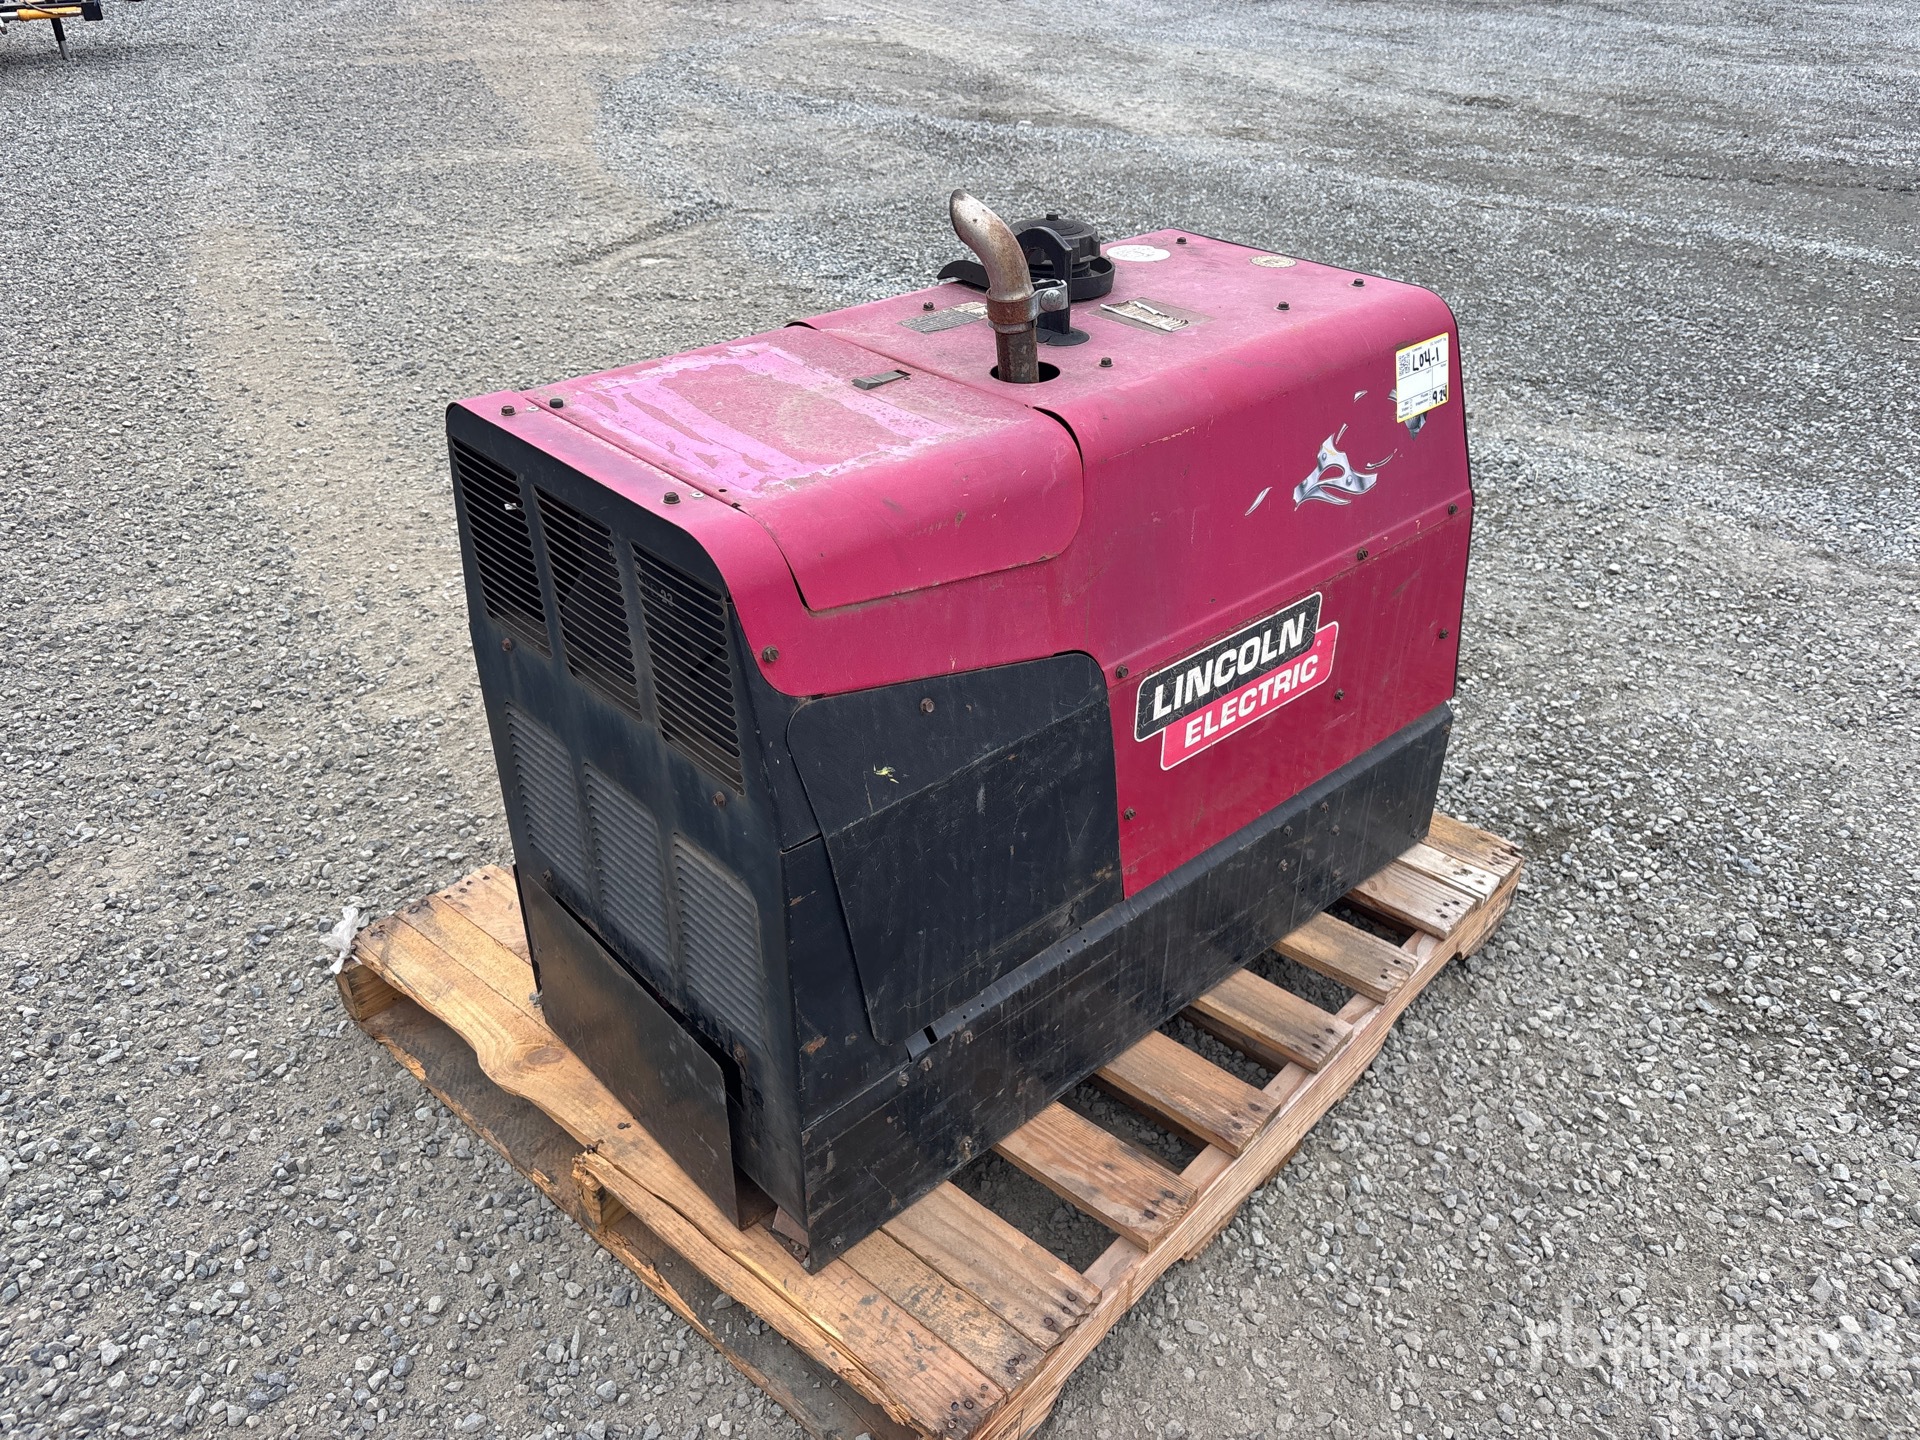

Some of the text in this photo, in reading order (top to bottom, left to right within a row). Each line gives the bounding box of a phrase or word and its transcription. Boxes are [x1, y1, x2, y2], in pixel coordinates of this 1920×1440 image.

[1412, 347, 1439, 371] L04-1
[1152, 611, 1306, 722] LINCOLN
[1184, 654, 1319, 750] ELECTRIC
